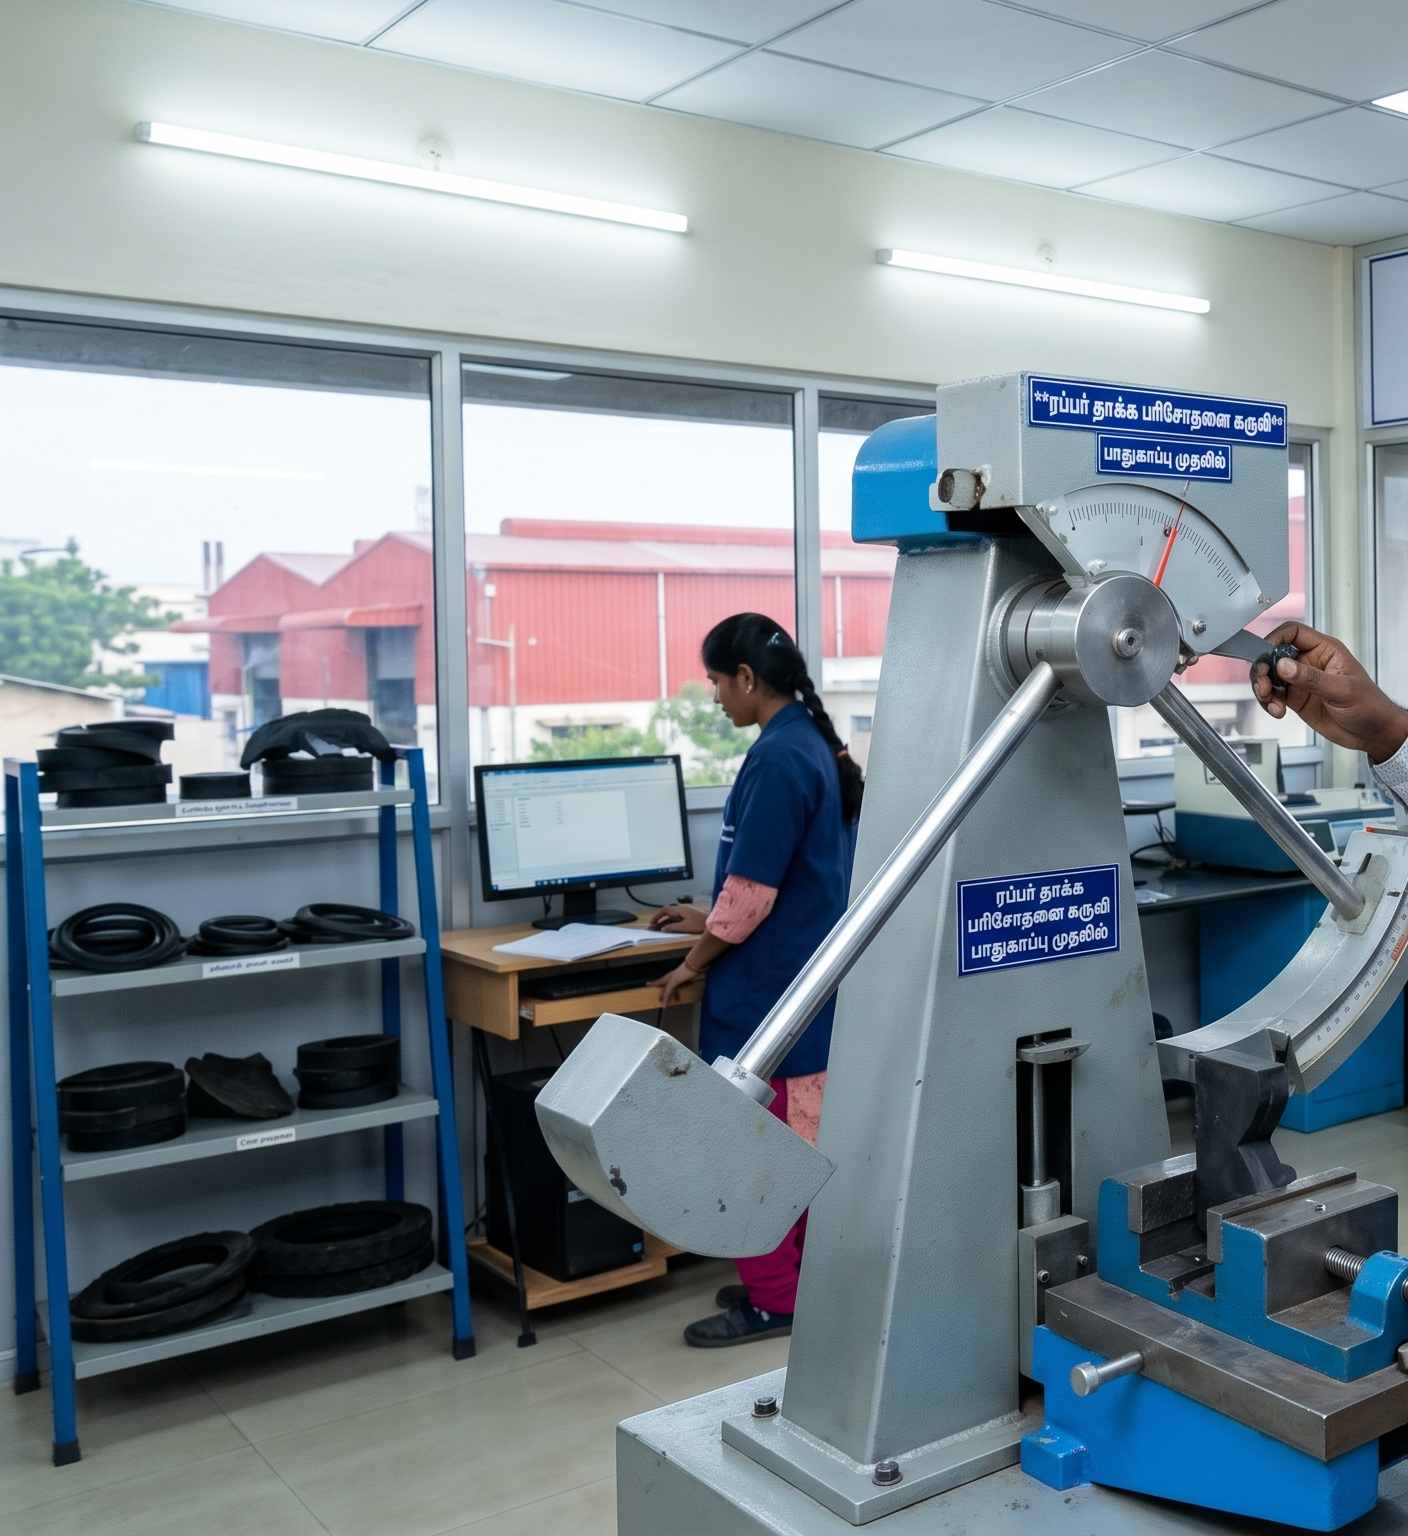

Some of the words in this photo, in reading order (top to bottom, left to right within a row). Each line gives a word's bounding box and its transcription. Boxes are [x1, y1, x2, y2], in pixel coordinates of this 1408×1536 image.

[1092, 395, 1139, 423] தாக்க
[1142, 400, 1231, 432] பரிசோதனை
[1103, 445, 1173, 469] பாதுகாப்பு
[1175, 450, 1226, 473] முதலில்
[995, 883, 1036, 908] ரப்பர்
[1039, 878, 1084, 904] தாக்க
[968, 907, 1064, 933] பரிசோதனை
[1067, 896, 1110, 922] கருவி
[971, 932, 1048, 962] பாதுகாப்பு
[1052, 922, 1108, 951] முதலில்
